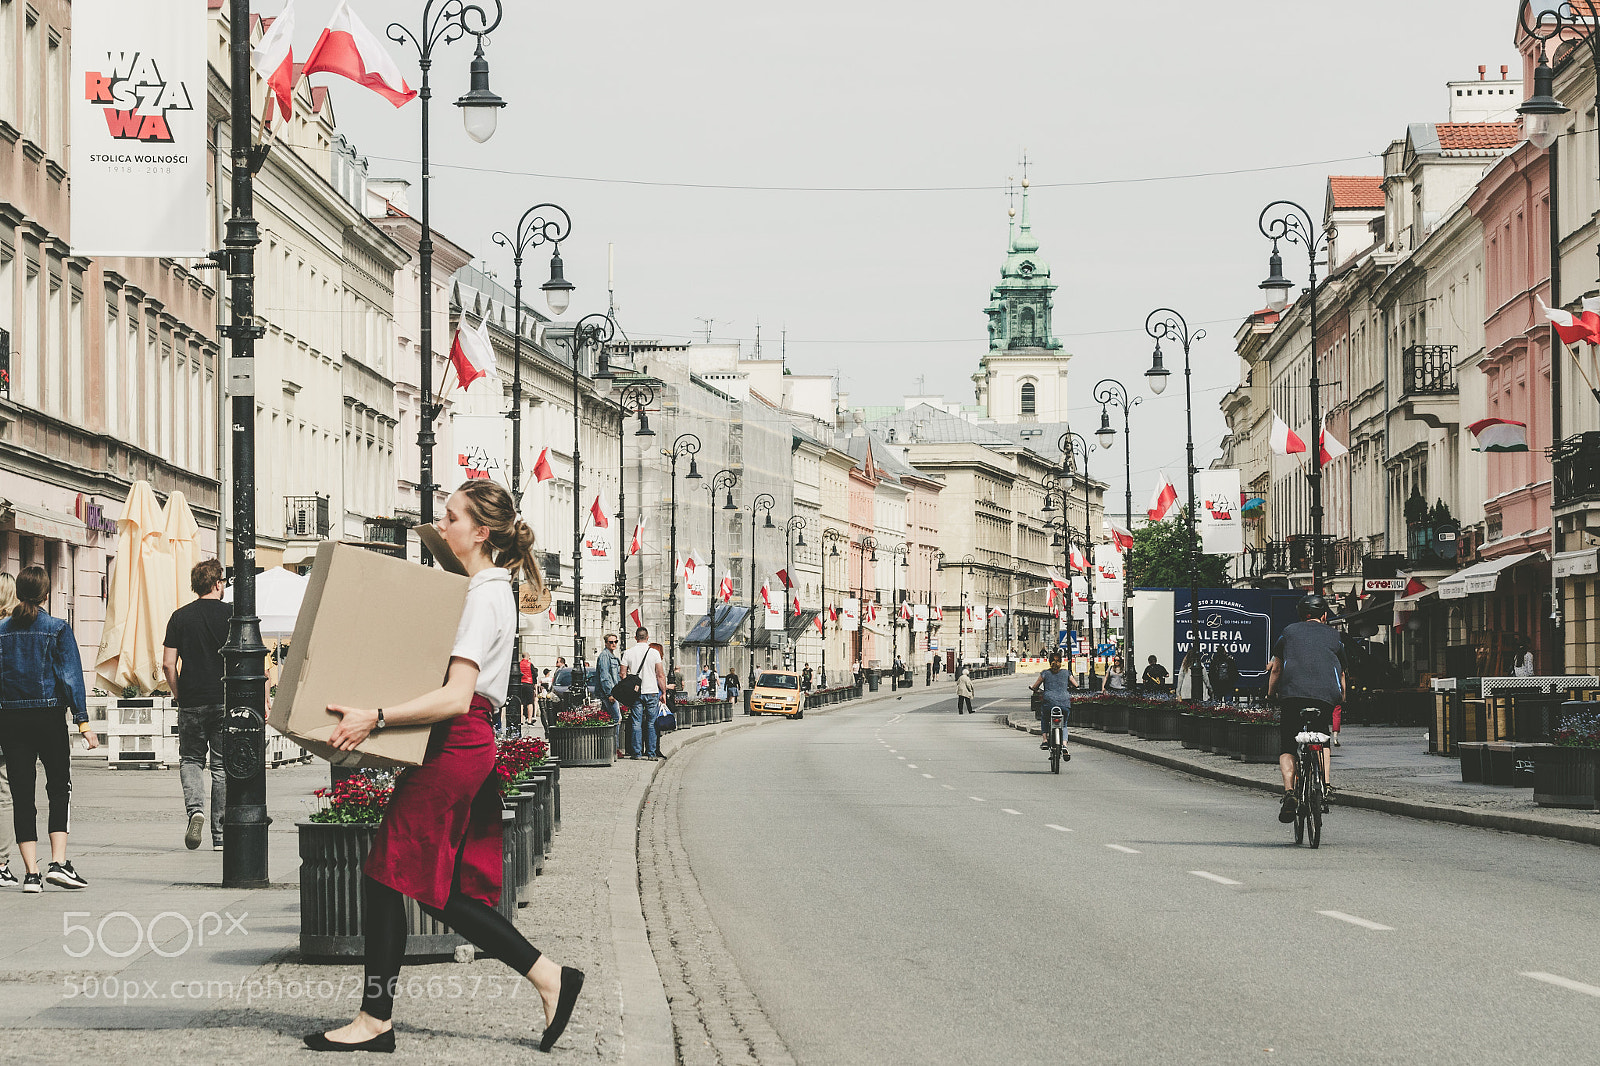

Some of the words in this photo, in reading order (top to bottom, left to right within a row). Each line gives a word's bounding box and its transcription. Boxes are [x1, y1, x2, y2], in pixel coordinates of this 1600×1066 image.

[90, 154, 132, 163] STOLICA
[134, 154, 188, 164] WOLNOŚCI
[107, 166, 132, 174] 1918
